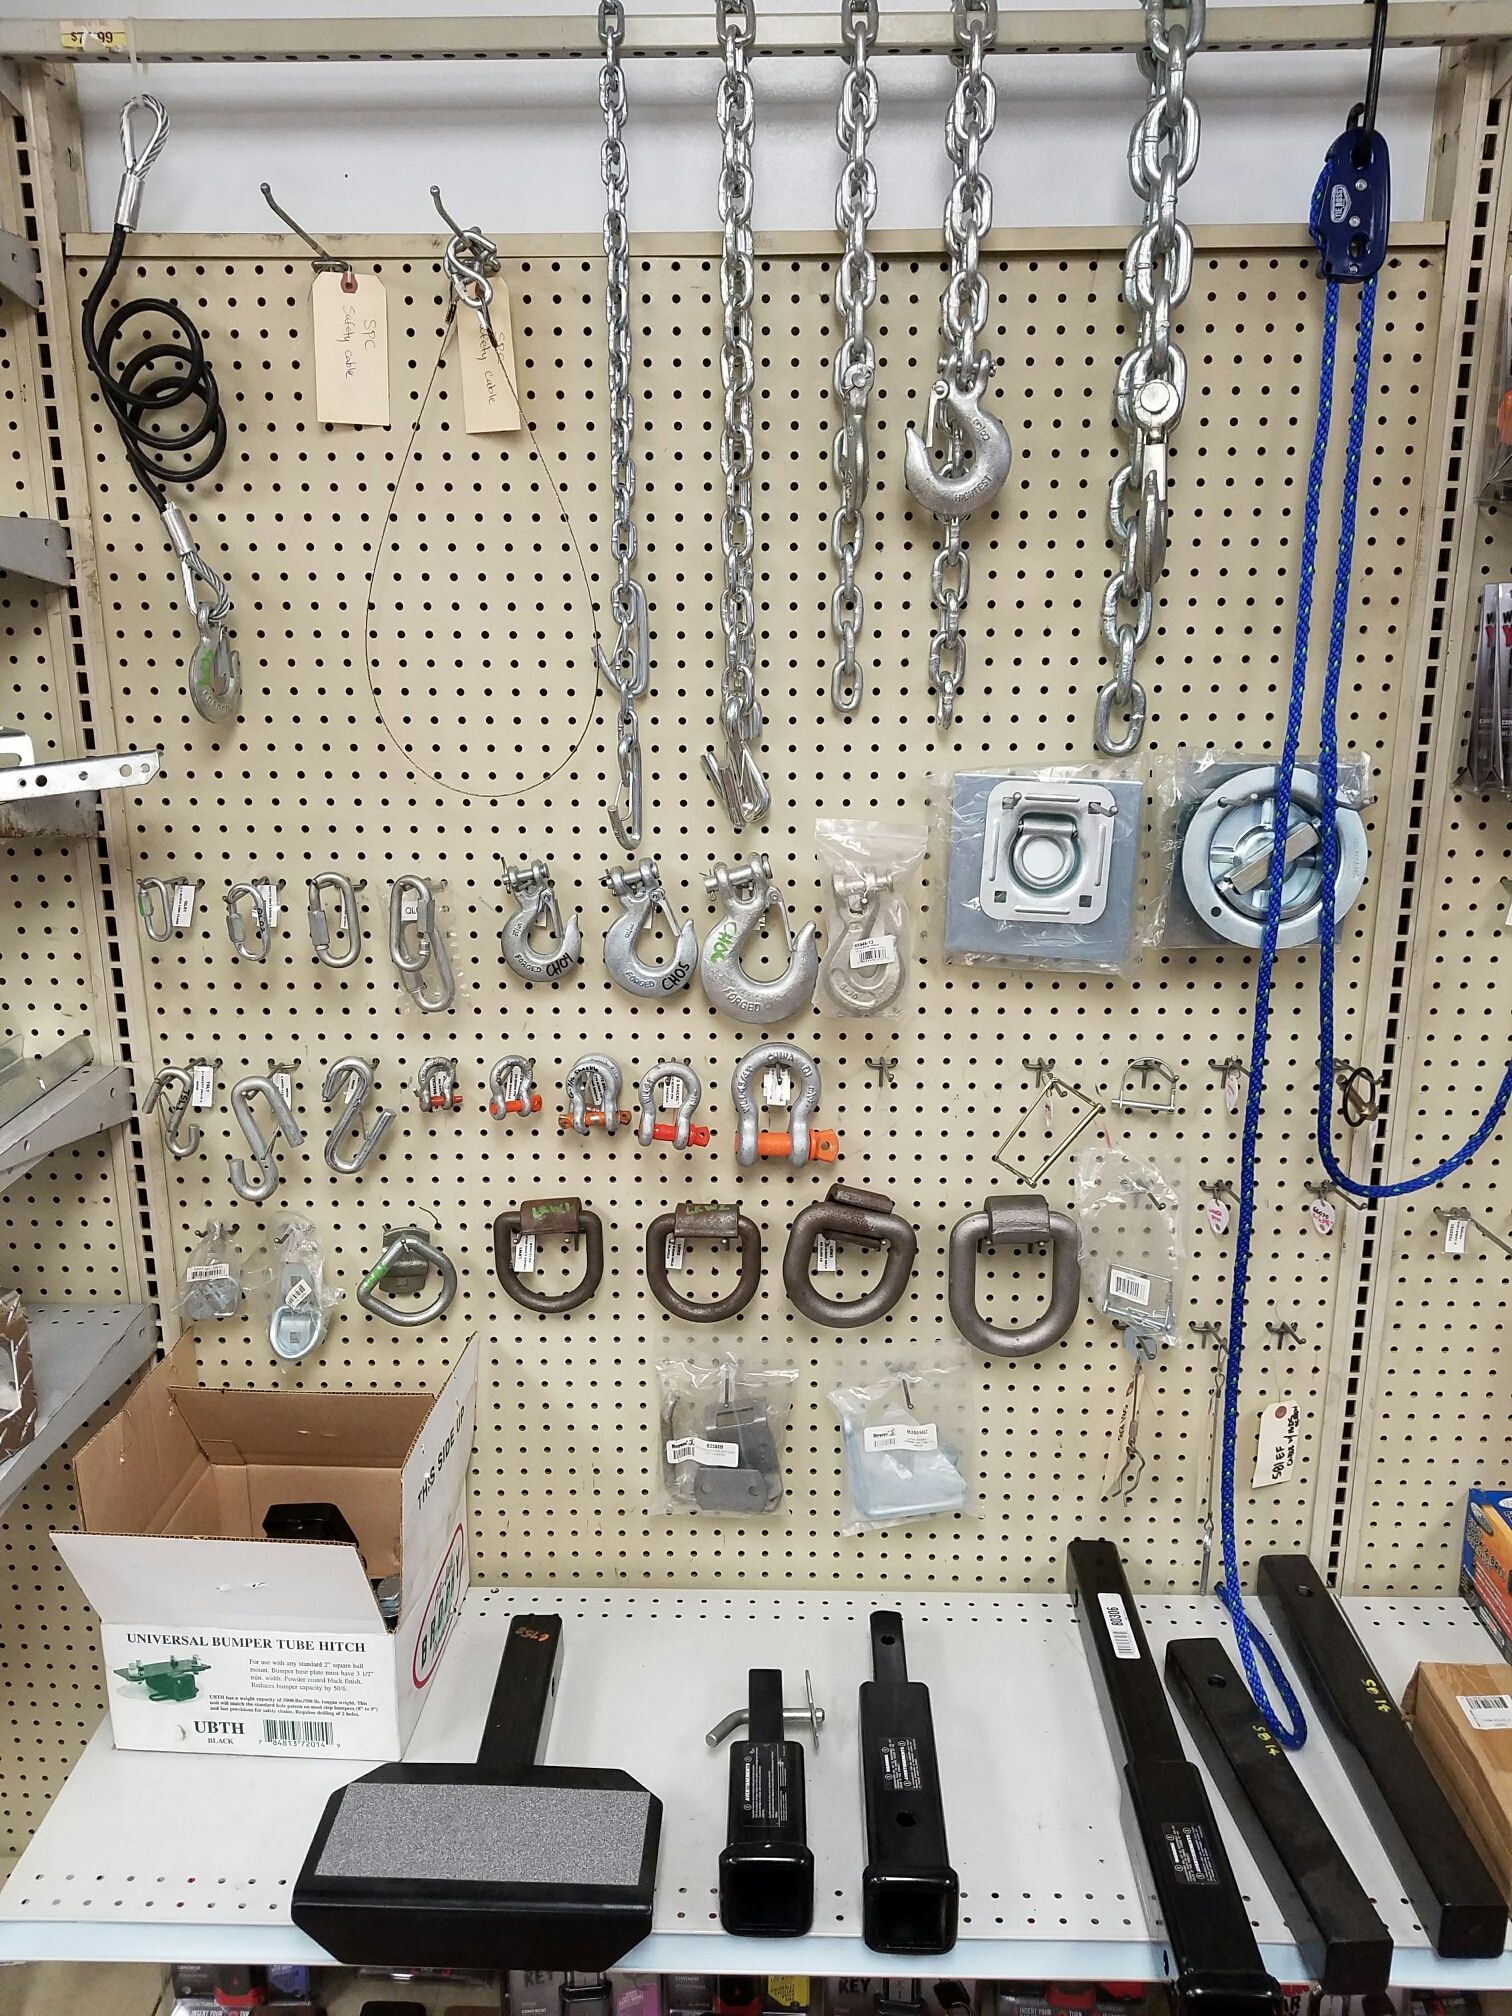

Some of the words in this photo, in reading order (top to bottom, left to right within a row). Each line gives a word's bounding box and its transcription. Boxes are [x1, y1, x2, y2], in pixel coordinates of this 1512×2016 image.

[1335, 189, 1344, 207] BOSS
[1335, 208, 1343, 219] TIE
[363, 319, 377, 350] SPC
[514, 954, 542, 973] FORGED
[626, 971, 655, 988] FORGED
[437, 1428, 455, 1471] SIDE
[455, 1405, 465, 1432] UP
[127, 1632, 208, 1647] UNIVERSAL
[212, 1637, 273, 1649] BUMPER
[276, 1639, 314, 1651] TUBE
[318, 1640, 366, 1652] HITCH
[193, 1720, 245, 1735] UBTH
[207, 1737, 234, 1745] BLACK
[300, 1740, 326, 1748] 72014
[838, 1977, 871, 1994] KEY
